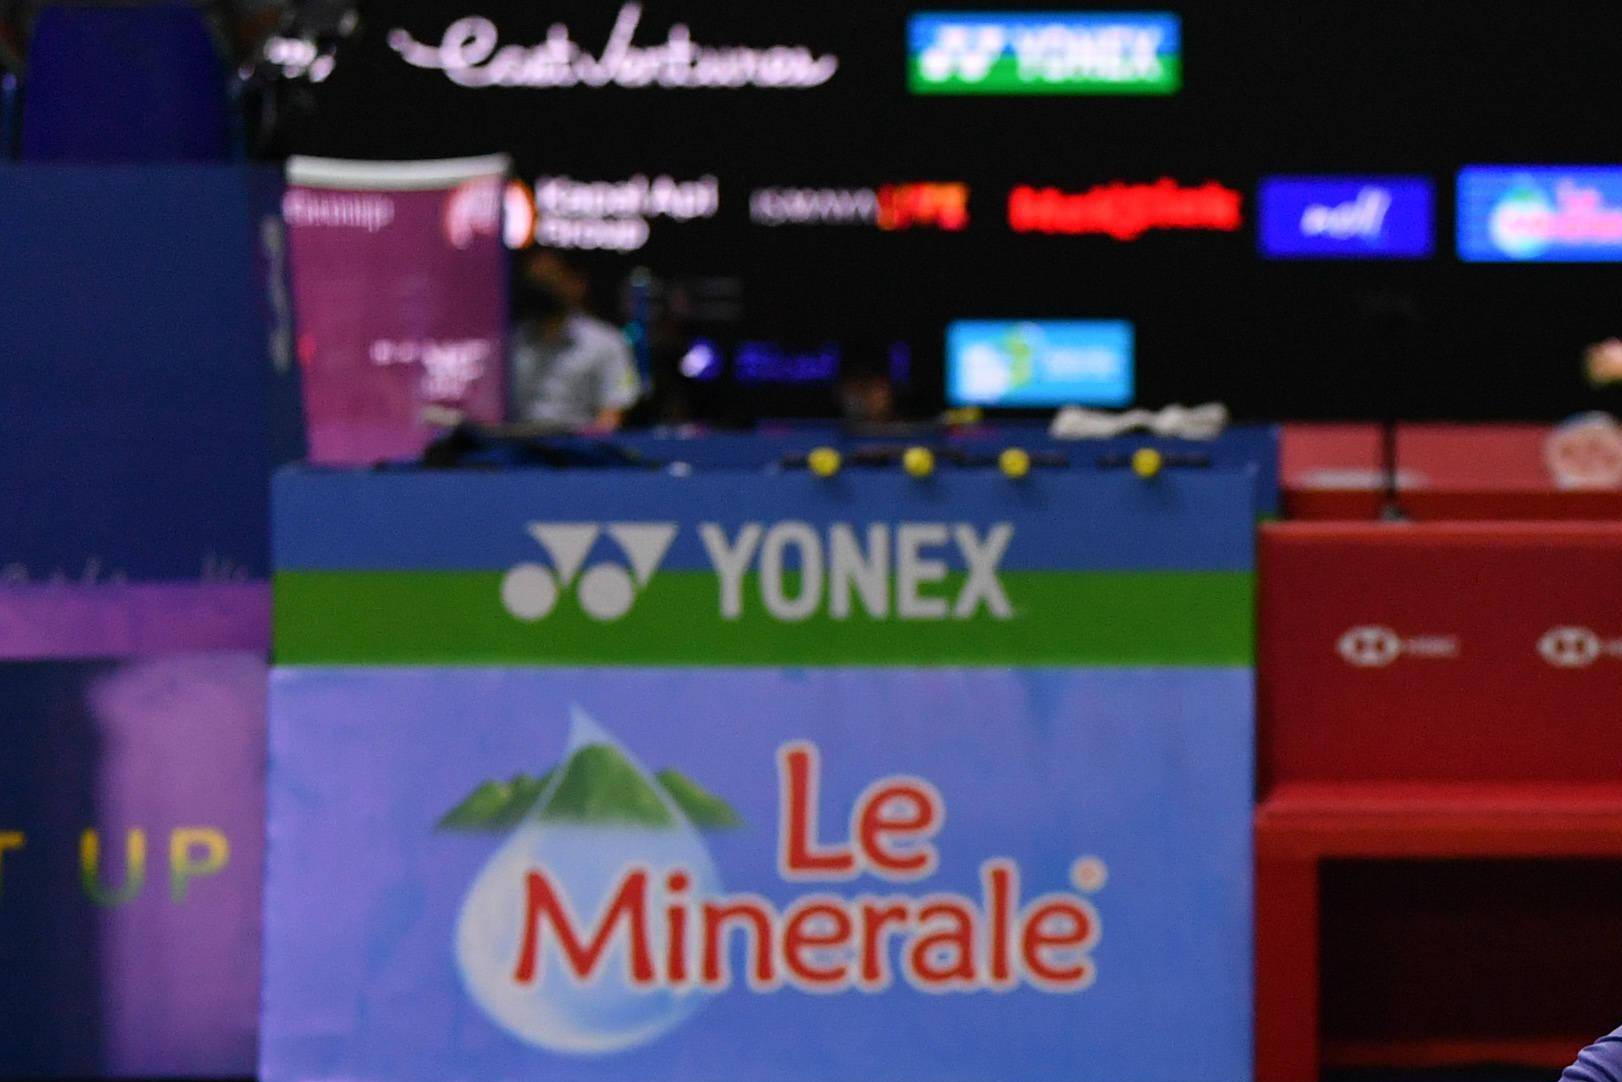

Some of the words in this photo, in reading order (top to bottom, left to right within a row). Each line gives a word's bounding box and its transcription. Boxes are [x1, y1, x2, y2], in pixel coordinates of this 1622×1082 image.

[698, 521, 1015, 620] YONEX
[80, 826, 231, 906] UP
[779, 741, 944, 880] Le
[510, 858, 1102, 991] Minerale
